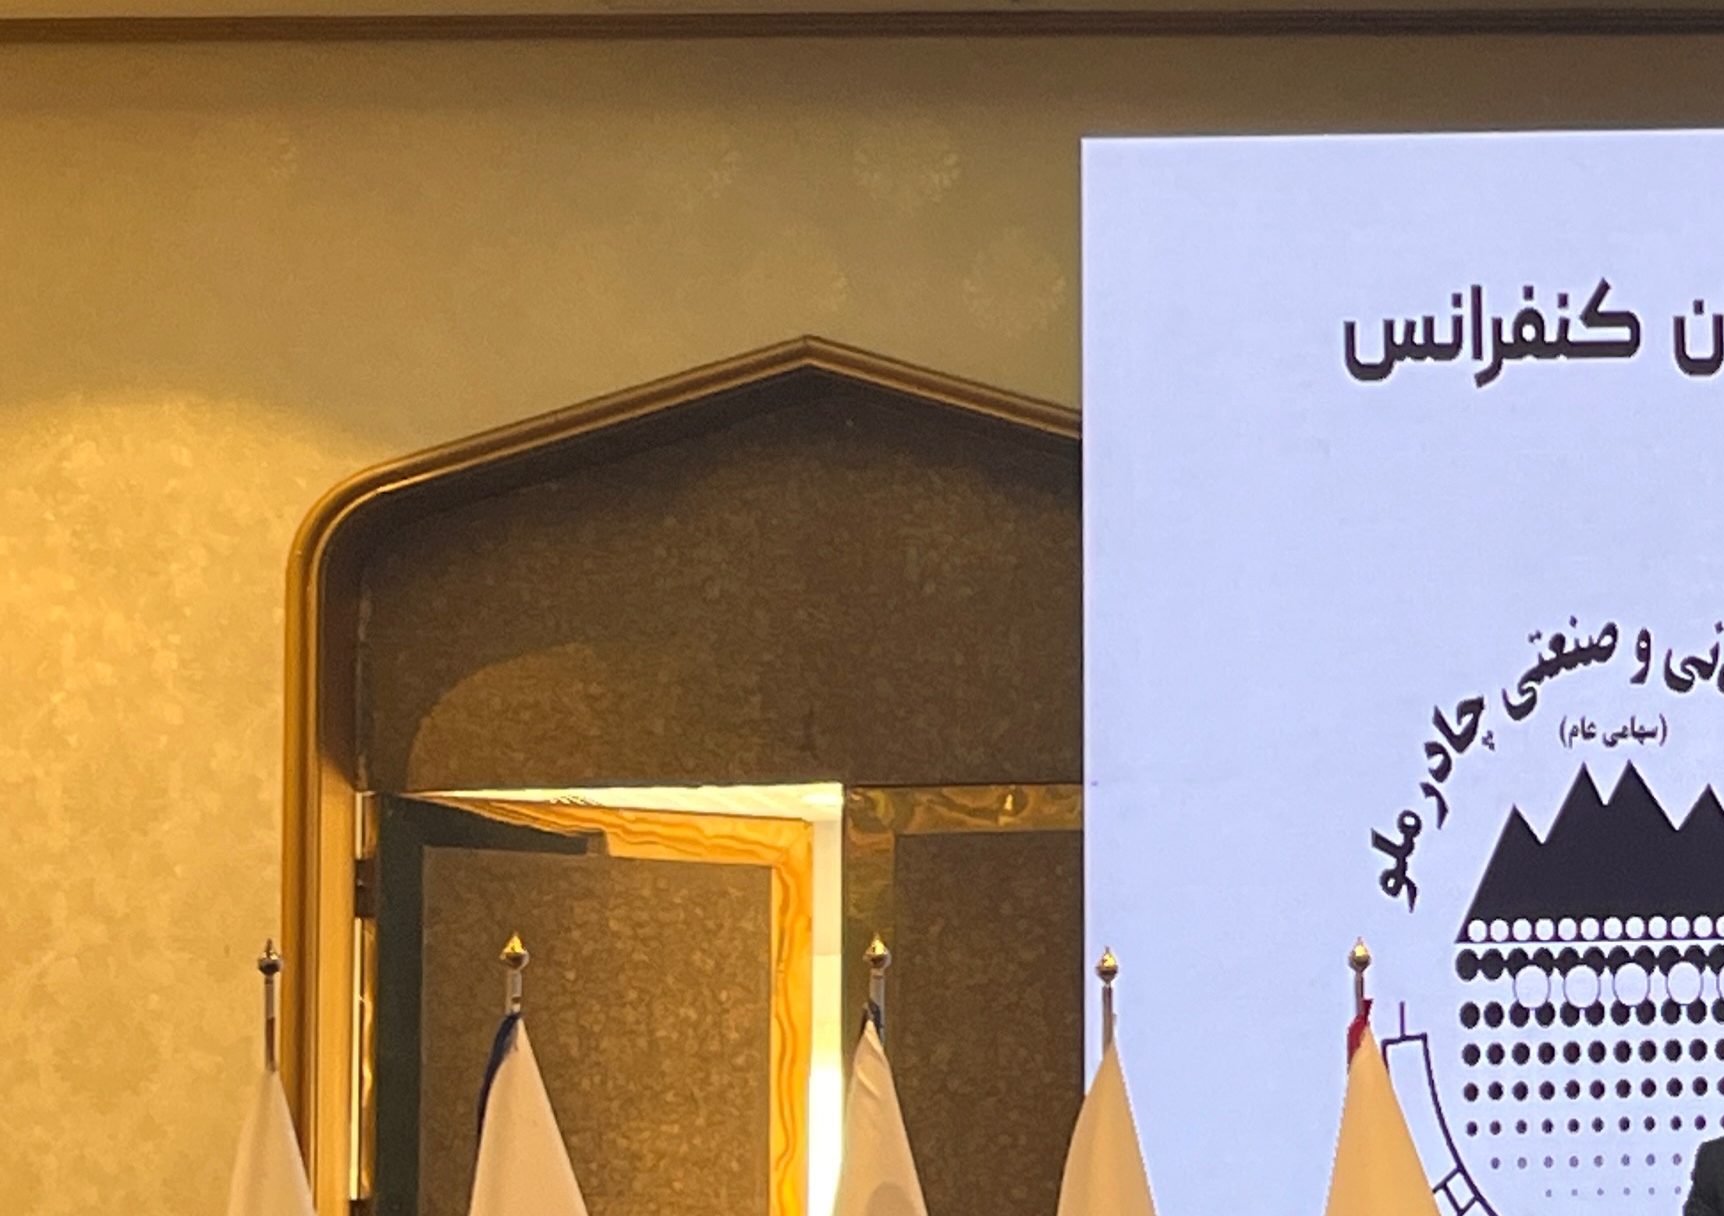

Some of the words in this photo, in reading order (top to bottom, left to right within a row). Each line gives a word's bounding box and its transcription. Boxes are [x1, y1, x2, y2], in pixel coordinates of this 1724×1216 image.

[1343, 277, 1643, 389] کنفرانس
[1501, 615, 1621, 722] صنعتی
[1629, 627, 1656, 684] و
